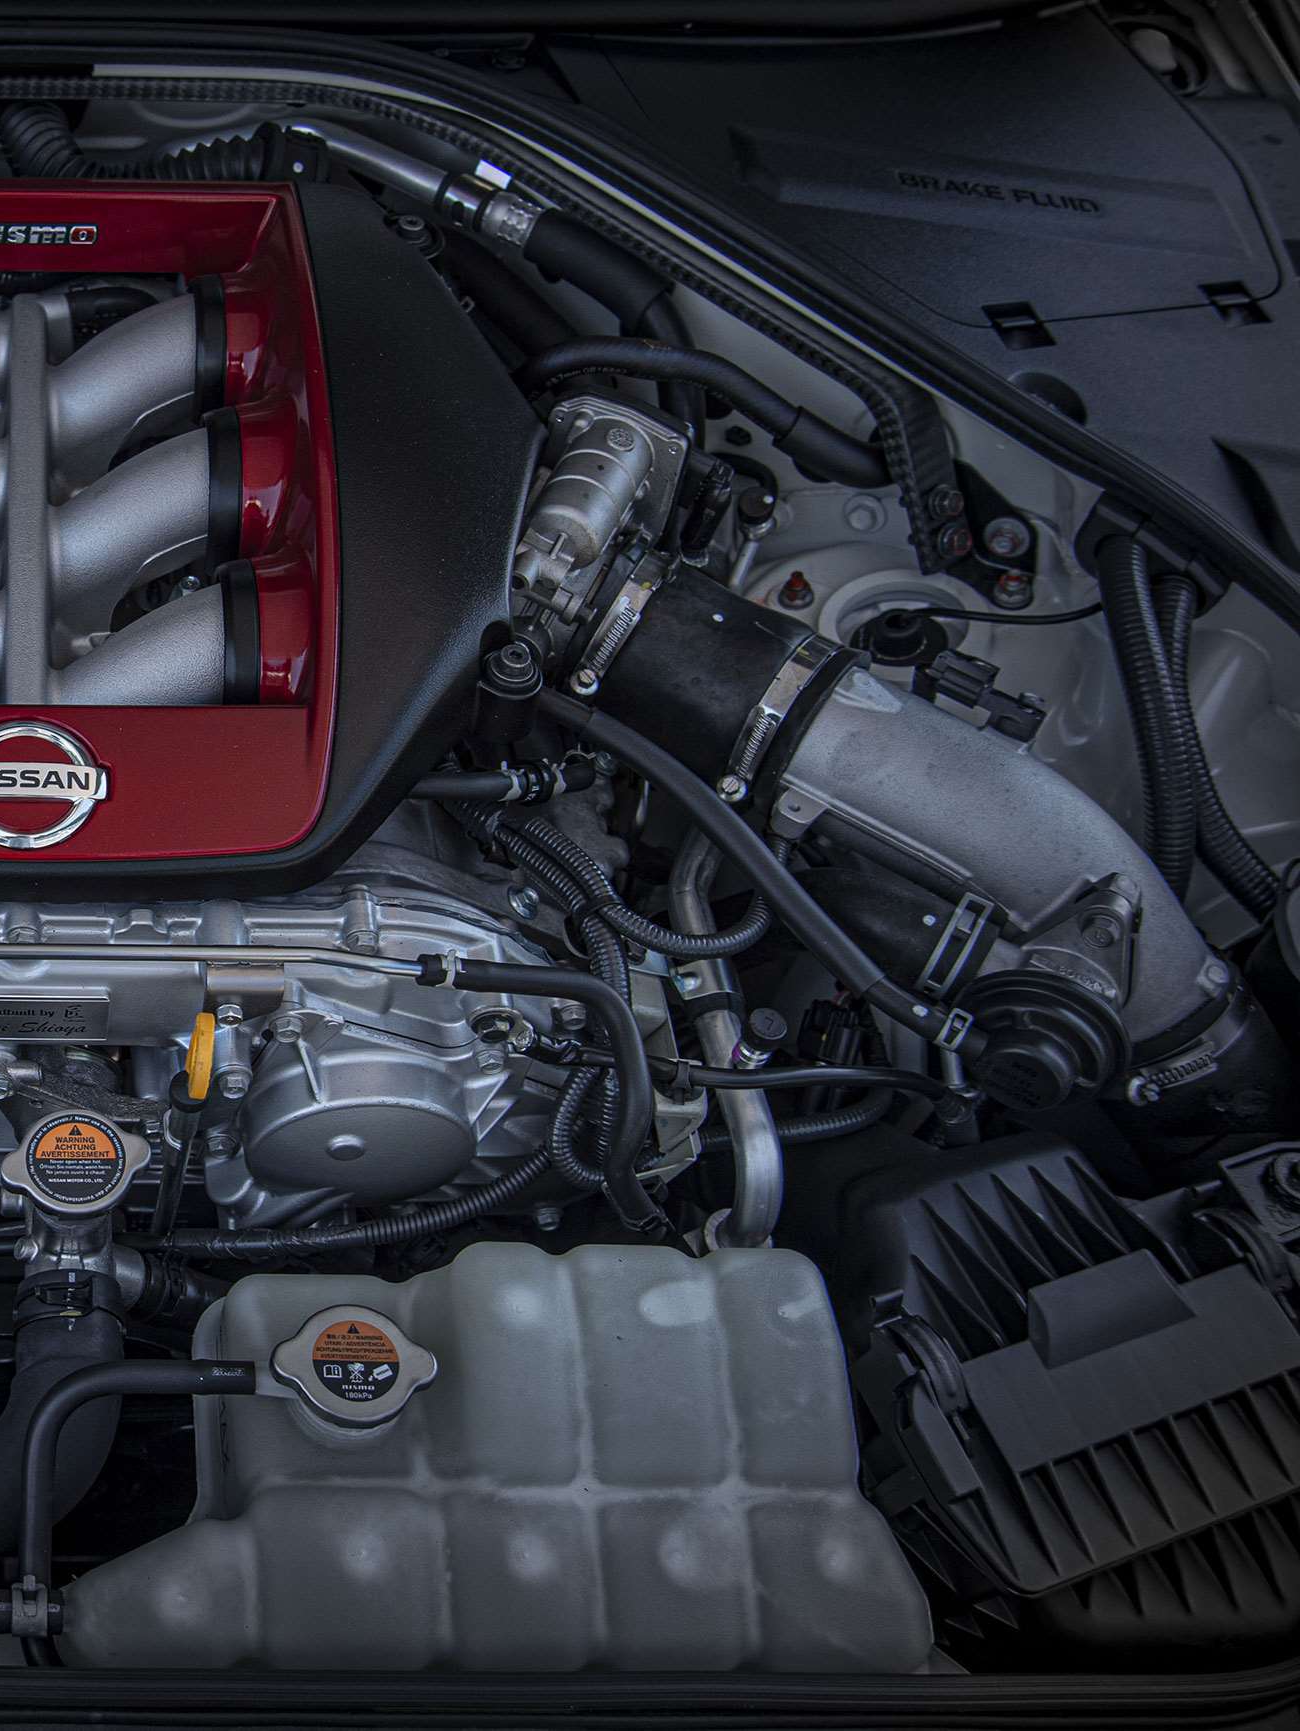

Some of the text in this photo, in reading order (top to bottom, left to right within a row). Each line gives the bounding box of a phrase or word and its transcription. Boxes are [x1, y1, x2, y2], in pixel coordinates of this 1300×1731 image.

[898, 172, 1100, 213] BRAKE FLUID
[40, 1008, 54, 1018] by
[18, 1021, 87, 1036] Shioya
[54, 1143, 96, 1151] ACHTUNG
[41, 1150, 110, 1158] AVERTISSEMENT
